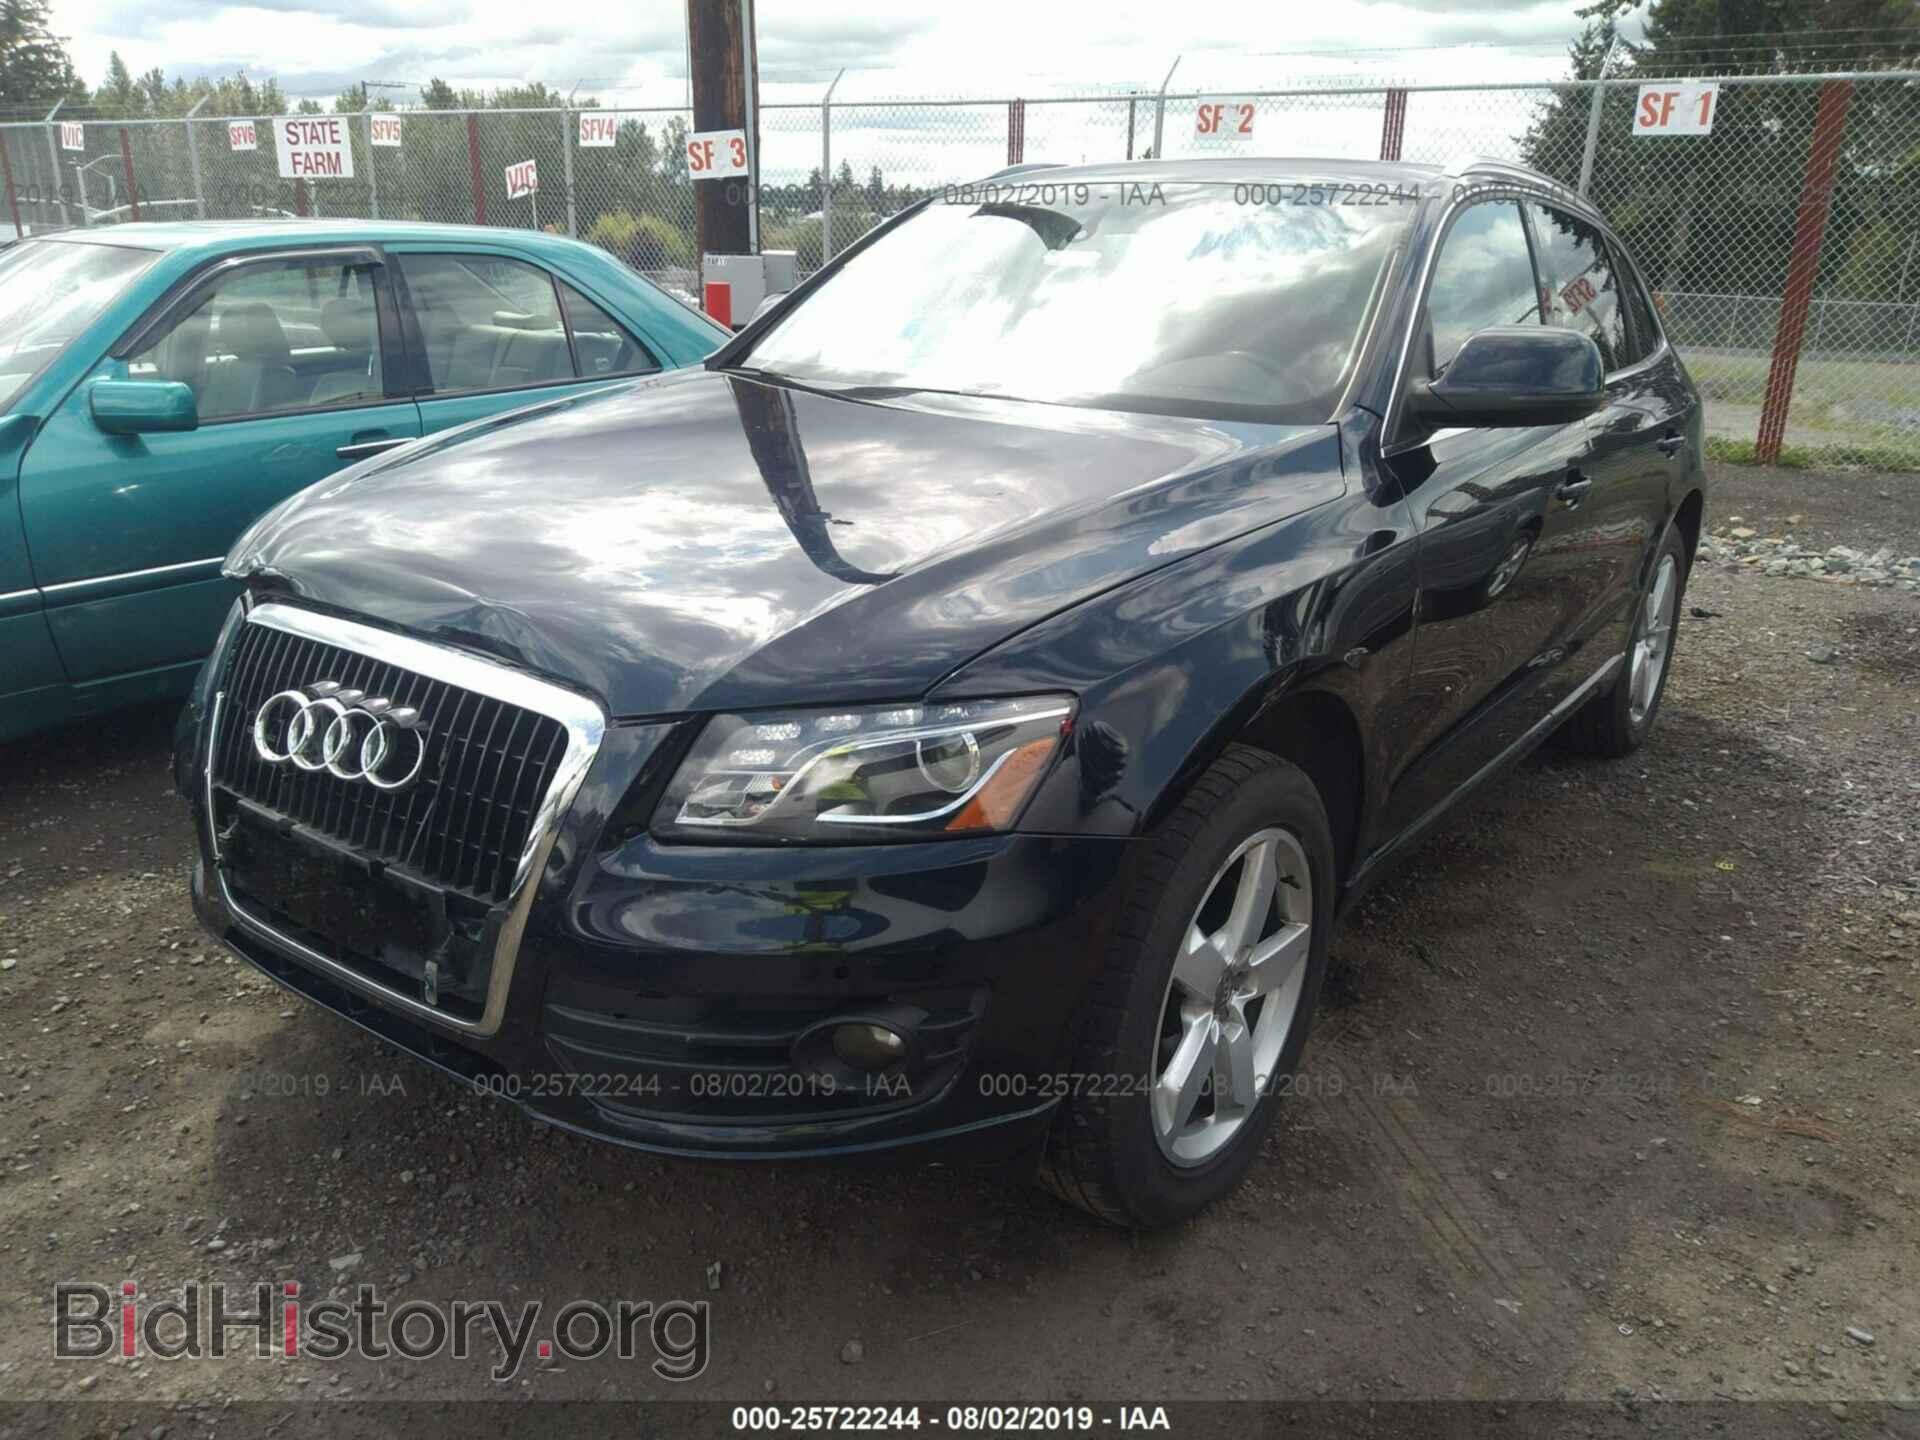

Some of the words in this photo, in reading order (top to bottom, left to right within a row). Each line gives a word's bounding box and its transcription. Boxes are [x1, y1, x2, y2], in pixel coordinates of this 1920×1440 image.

[1197, 103, 1225, 134] SF
[1238, 103, 1255, 133] 2
[1639, 92, 1681, 128] SF
[1697, 90, 1713, 127] 1
[62, 124, 83, 147] VIC
[231, 125, 256, 146] SFV6
[286, 120, 342, 146] STATE
[371, 120, 400, 141] SFV5
[580, 118, 615, 142] SFV4
[291, 151, 343, 177] FARM
[687, 140, 715, 172] SF
[729, 137, 746, 168] 3
[507, 164, 537, 194] VIC
